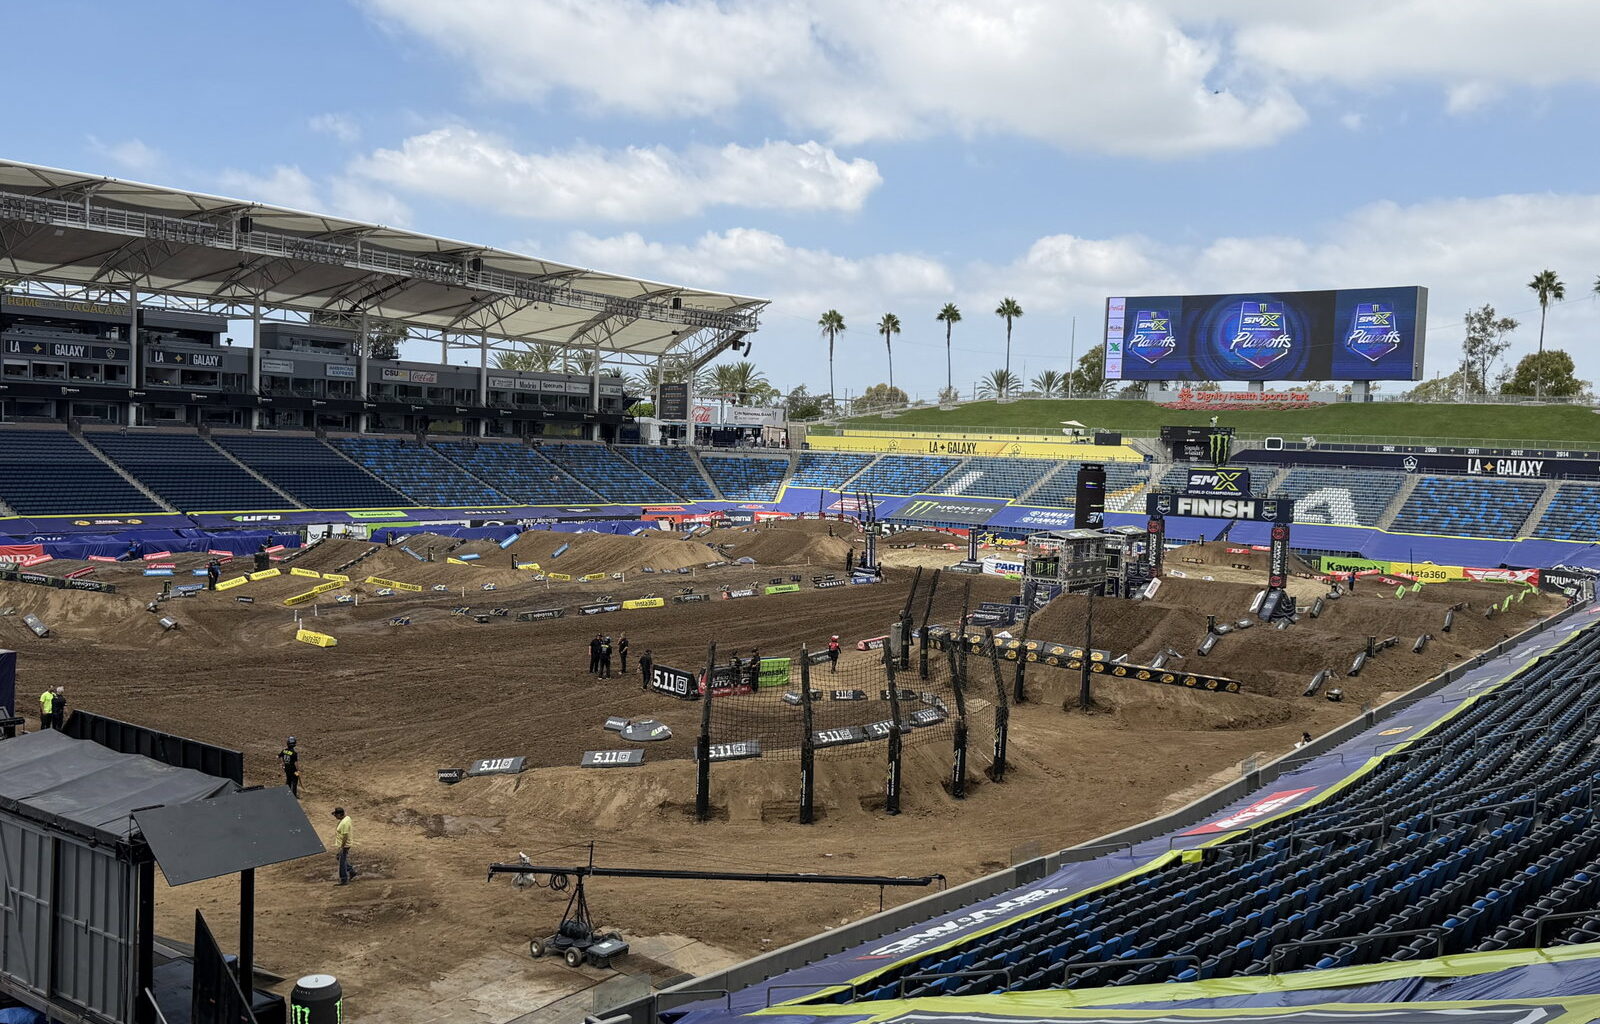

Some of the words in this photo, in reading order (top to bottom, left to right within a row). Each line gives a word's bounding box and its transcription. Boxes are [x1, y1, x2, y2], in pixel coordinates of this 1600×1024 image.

[1243, 314, 1280, 326] SMX
[1359, 314, 1390, 324] SMX
[1128, 334, 1176, 349] Playoffs
[1230, 332, 1292, 349] Playoffs
[1348, 330, 1400, 346] Playoffs
[10, 340, 20, 352] LA
[54, 344, 84, 357] GALAXY
[154, 352, 164, 363] LA
[192, 354, 219, 366] GALAXY
[1197, 392, 1227, 402] Dignity
[1230, 392, 1258, 400] Health
[1260, 392, 1288, 402] Sports
[1291, 393, 1309, 401] Park
[929, 441, 938, 453] LA
[948, 442, 976, 454] GALAXY
[1468, 458, 1481, 474] LA
[1496, 459, 1543, 476] GALAXY
[1189, 472, 1242, 491] SMX
[935, 504, 994, 513] MONSTER
[1178, 498, 1255, 519] FINISH
[302, 634, 321, 645] Insta360
[653, 669, 675, 692] 5.11
[836, 690, 847, 699] 5.11
[818, 731, 842, 742] 5.11
[592, 752, 617, 763] 5.11
[709, 745, 733, 758] 5.11
[480, 759, 501, 771] 5.11
[438, 771, 458, 780] peacock
